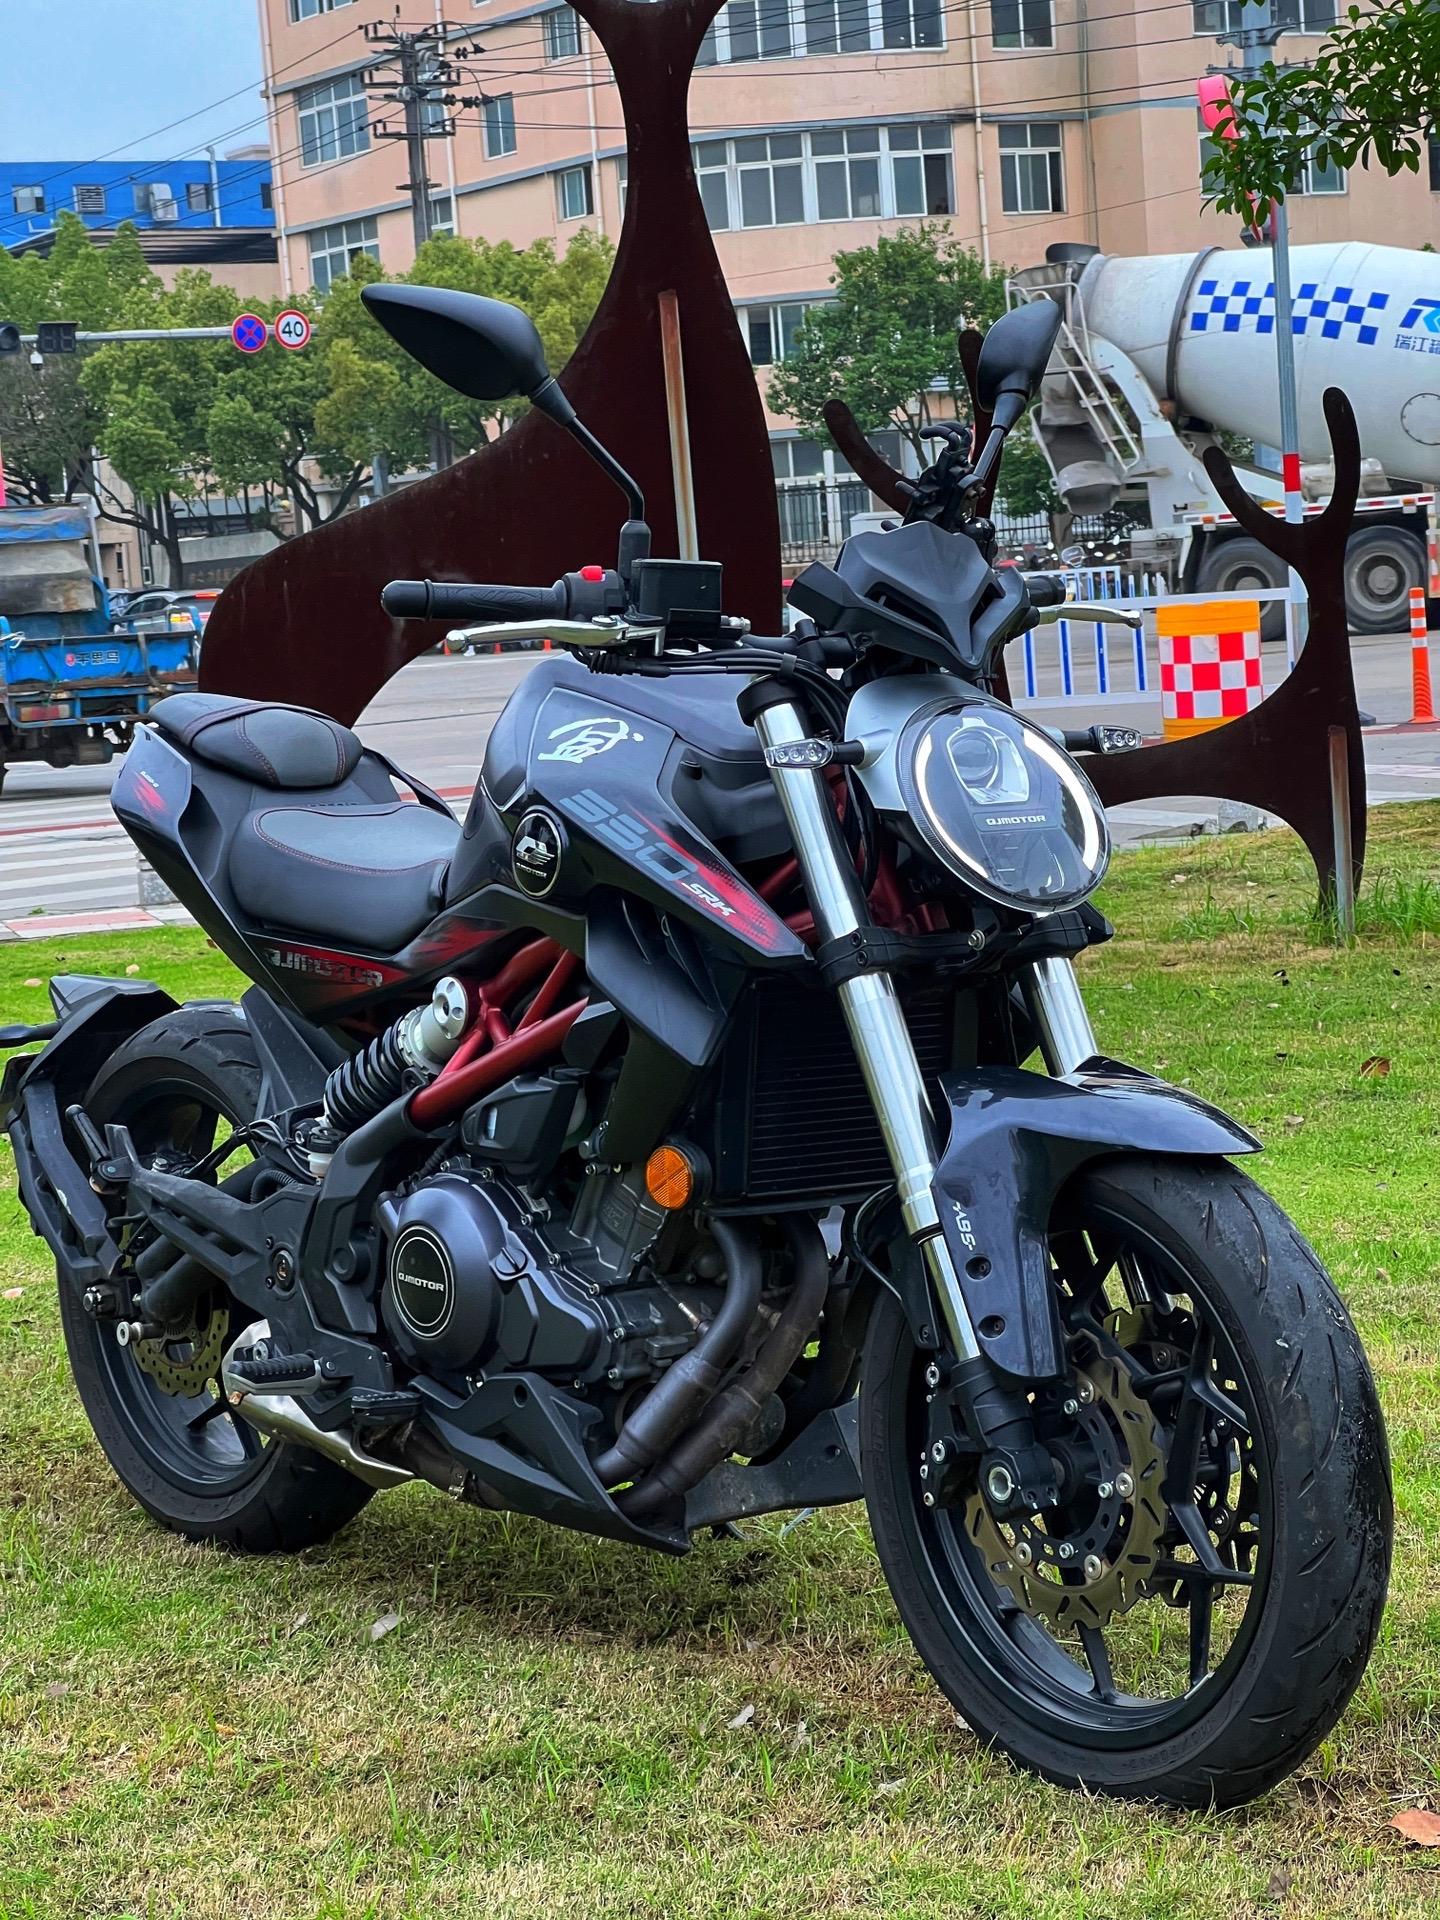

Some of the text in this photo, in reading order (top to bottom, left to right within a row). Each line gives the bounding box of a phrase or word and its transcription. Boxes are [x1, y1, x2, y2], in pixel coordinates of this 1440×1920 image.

[282, 321, 304, 338] 40
[986, 815, 1047, 826] QJMOTOR
[559, 788, 736, 917] 350 SRK
[952, 1201, 976, 1251] ABS
[398, 1272, 445, 1292] QJMOTOR
